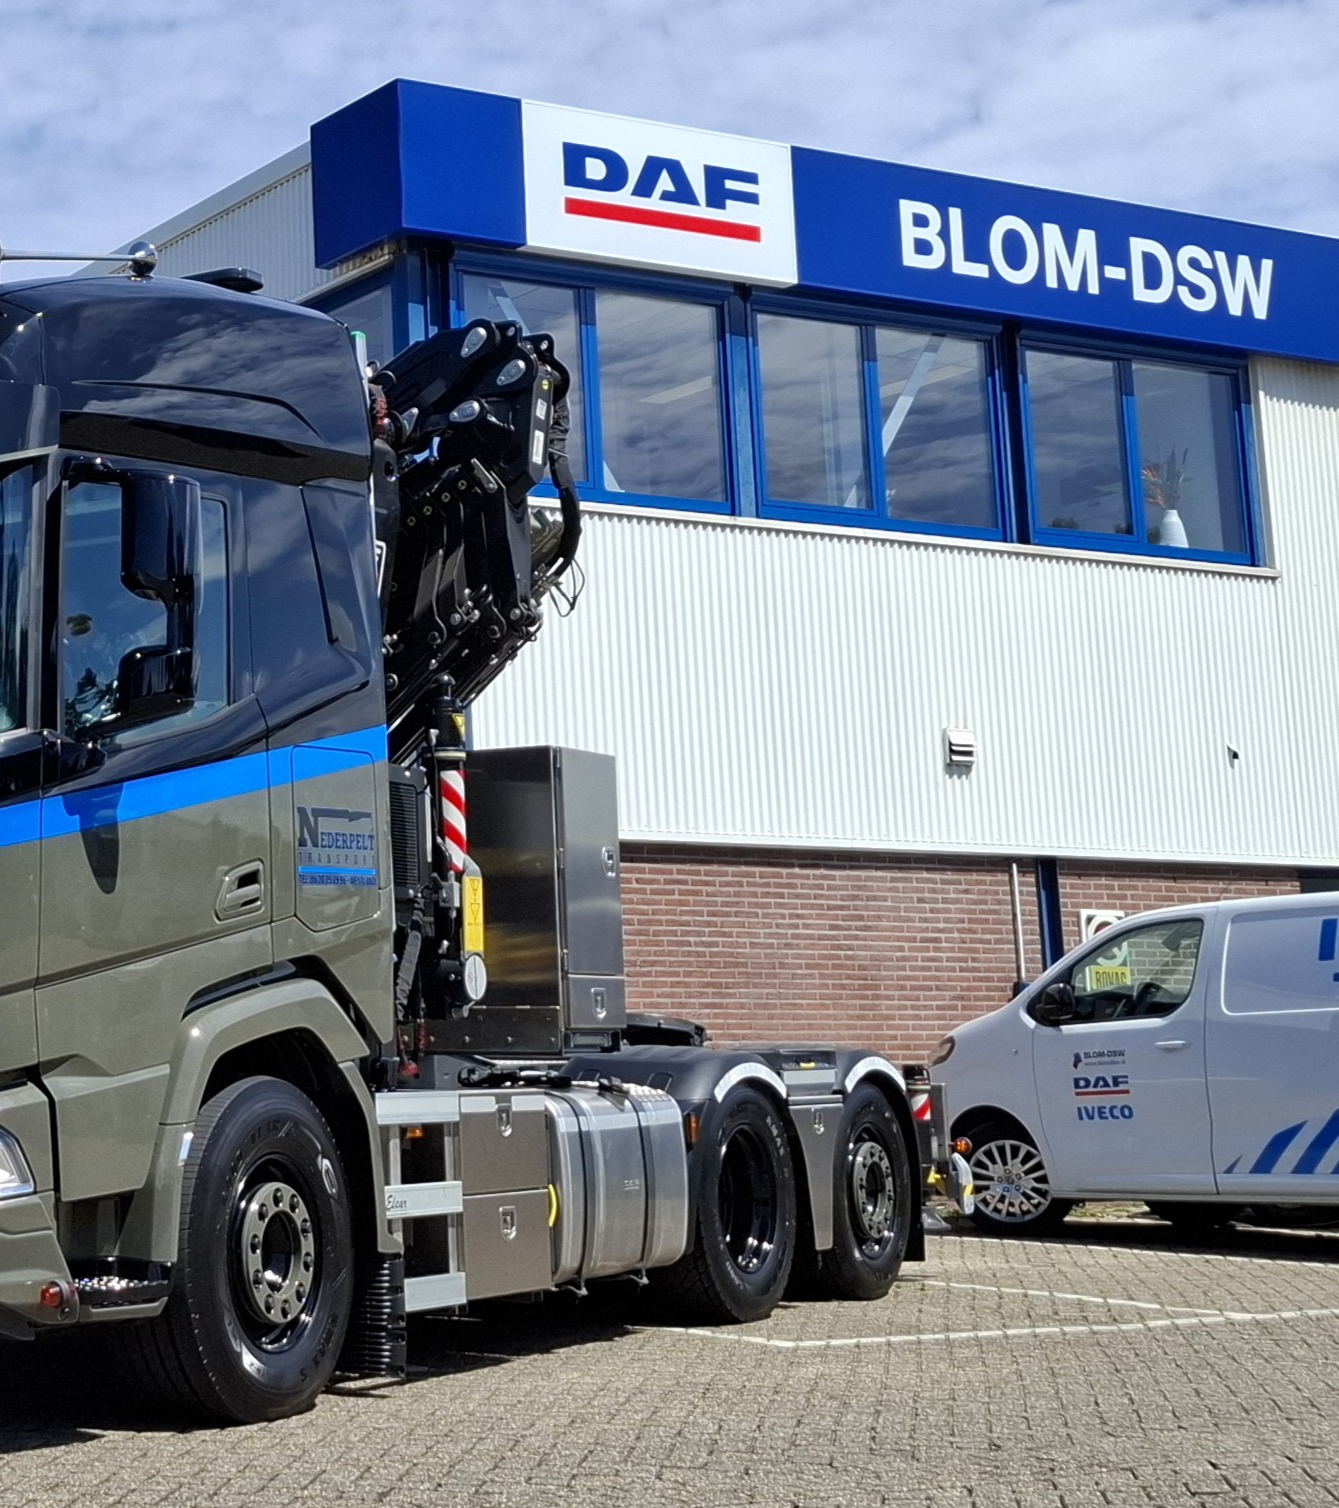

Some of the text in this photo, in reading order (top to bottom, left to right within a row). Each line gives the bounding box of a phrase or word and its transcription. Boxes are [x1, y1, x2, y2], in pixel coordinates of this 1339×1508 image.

[562, 141, 760, 211] DAF
[898, 198, 1274, 320] BLOM-DSW
[296, 805, 375, 851] NEDERPELT
[1083, 1049, 1126, 1059] BLOM-DSW
[1073, 1075, 1129, 1090] DAF
[1077, 1104, 1134, 1121] IVECO
